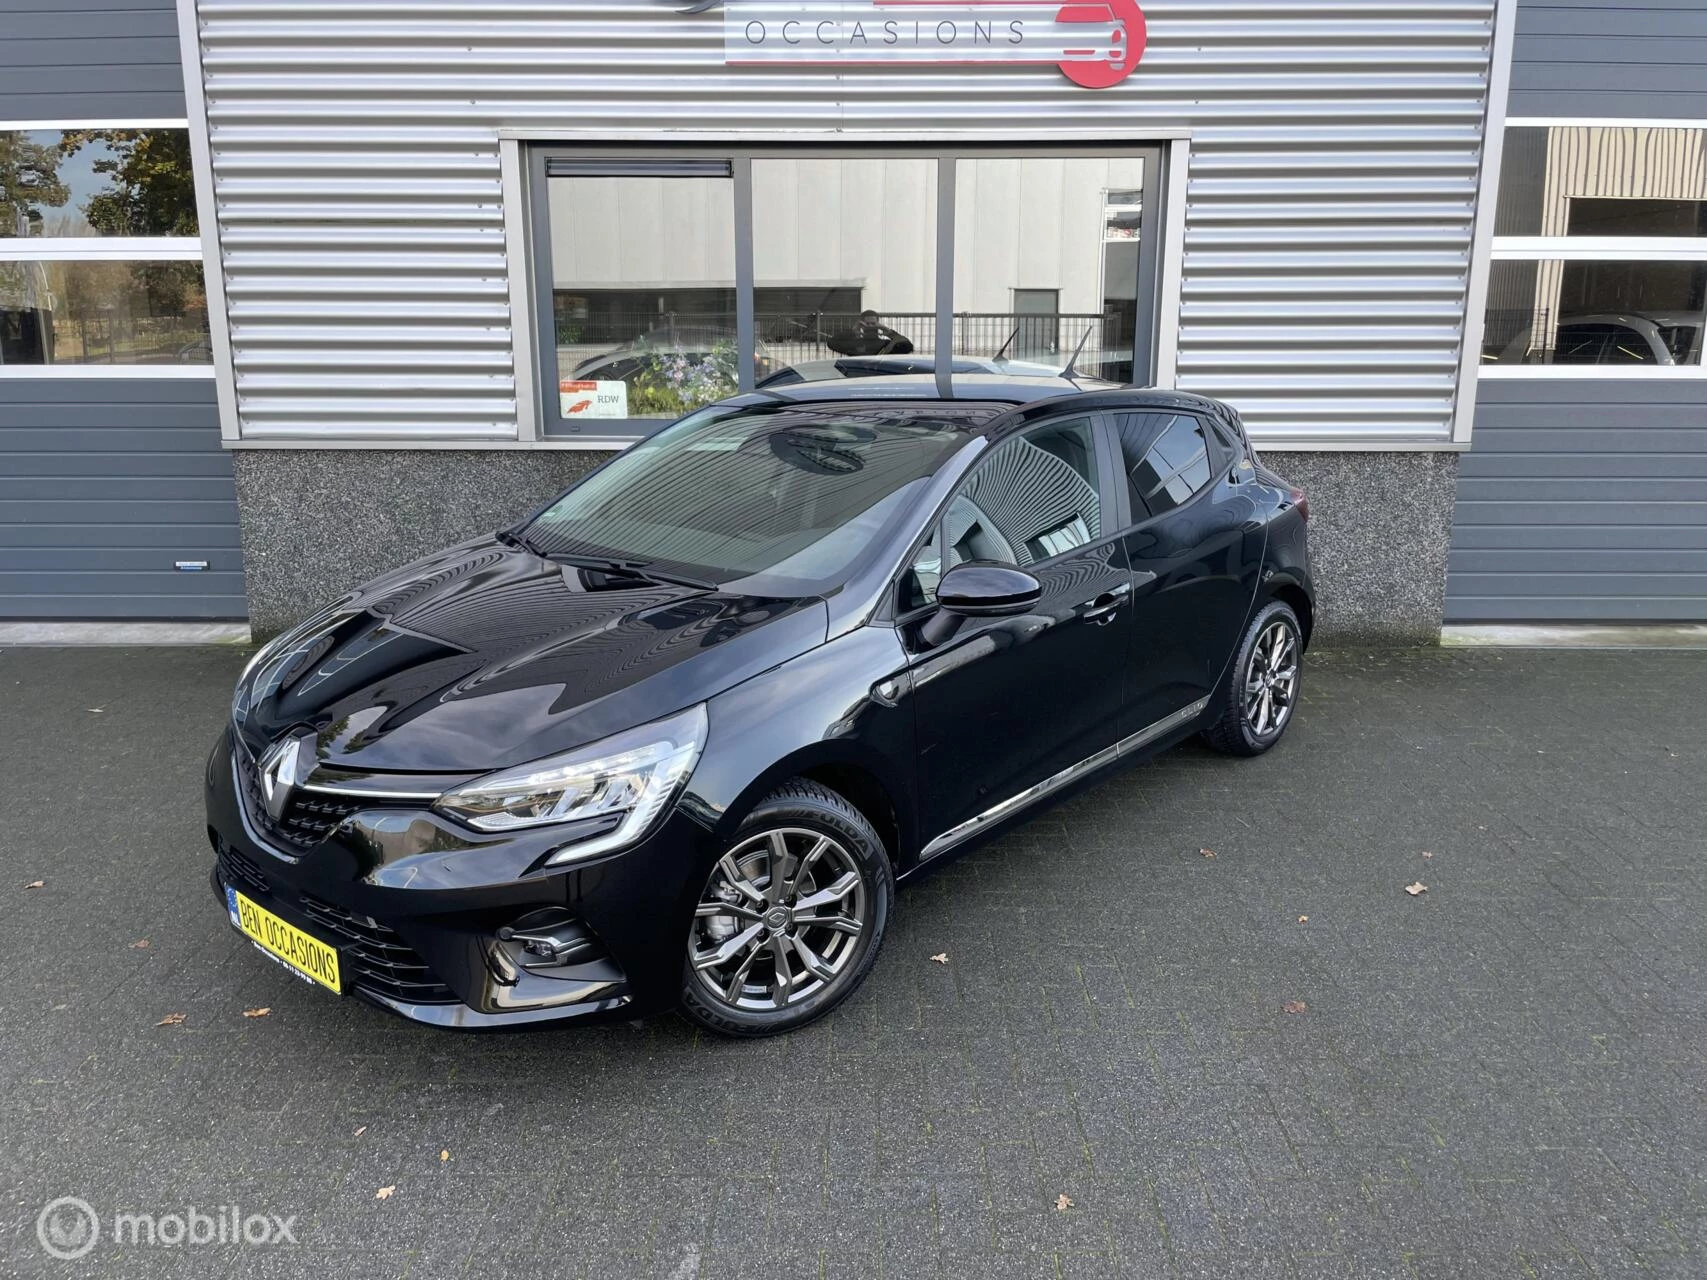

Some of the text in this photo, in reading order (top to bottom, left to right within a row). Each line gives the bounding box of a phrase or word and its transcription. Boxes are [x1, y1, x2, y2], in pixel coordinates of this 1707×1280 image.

[745, 20, 1024, 44] OCCASIONS
[597, 395, 619, 403] RDW
[240, 900, 263, 939] BEN
[265, 916, 336, 984] OCCASIONS
